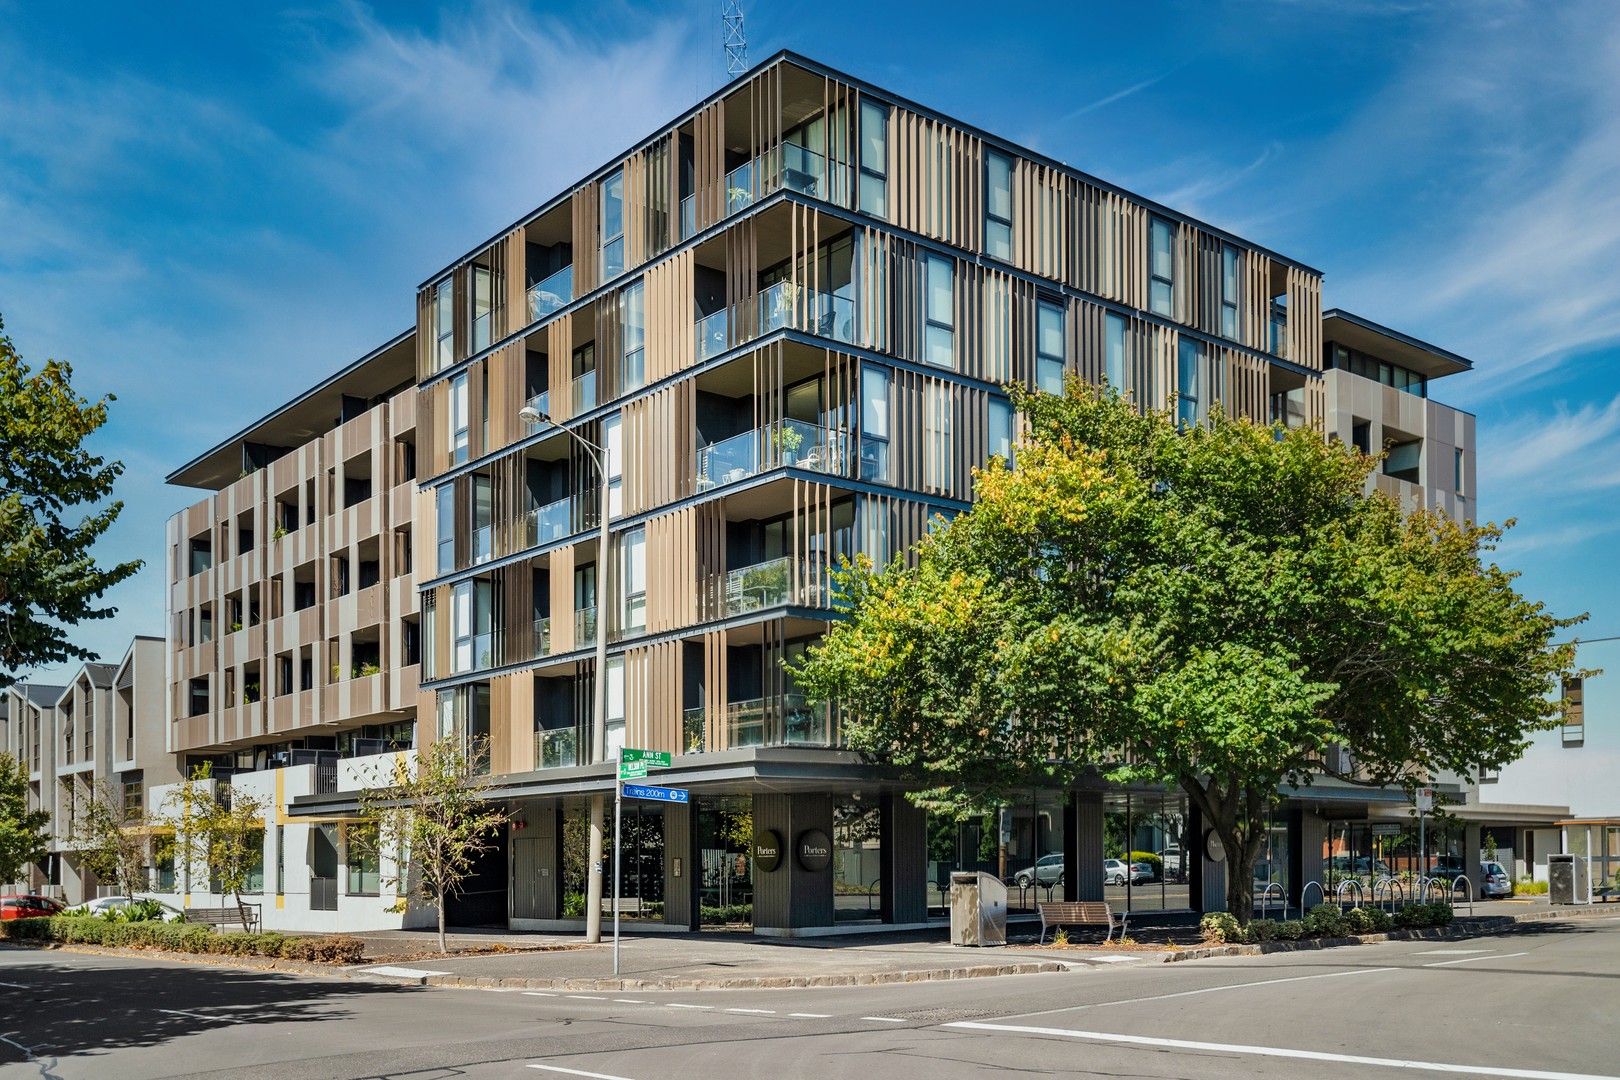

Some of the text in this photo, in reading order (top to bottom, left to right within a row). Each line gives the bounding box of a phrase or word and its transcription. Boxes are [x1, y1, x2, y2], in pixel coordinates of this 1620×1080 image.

[642, 751, 661, 760] ANN ST
[625, 786, 665, 798] Trains 200m
[757, 846, 776, 855] Porters
[804, 845, 827, 854] Porters
